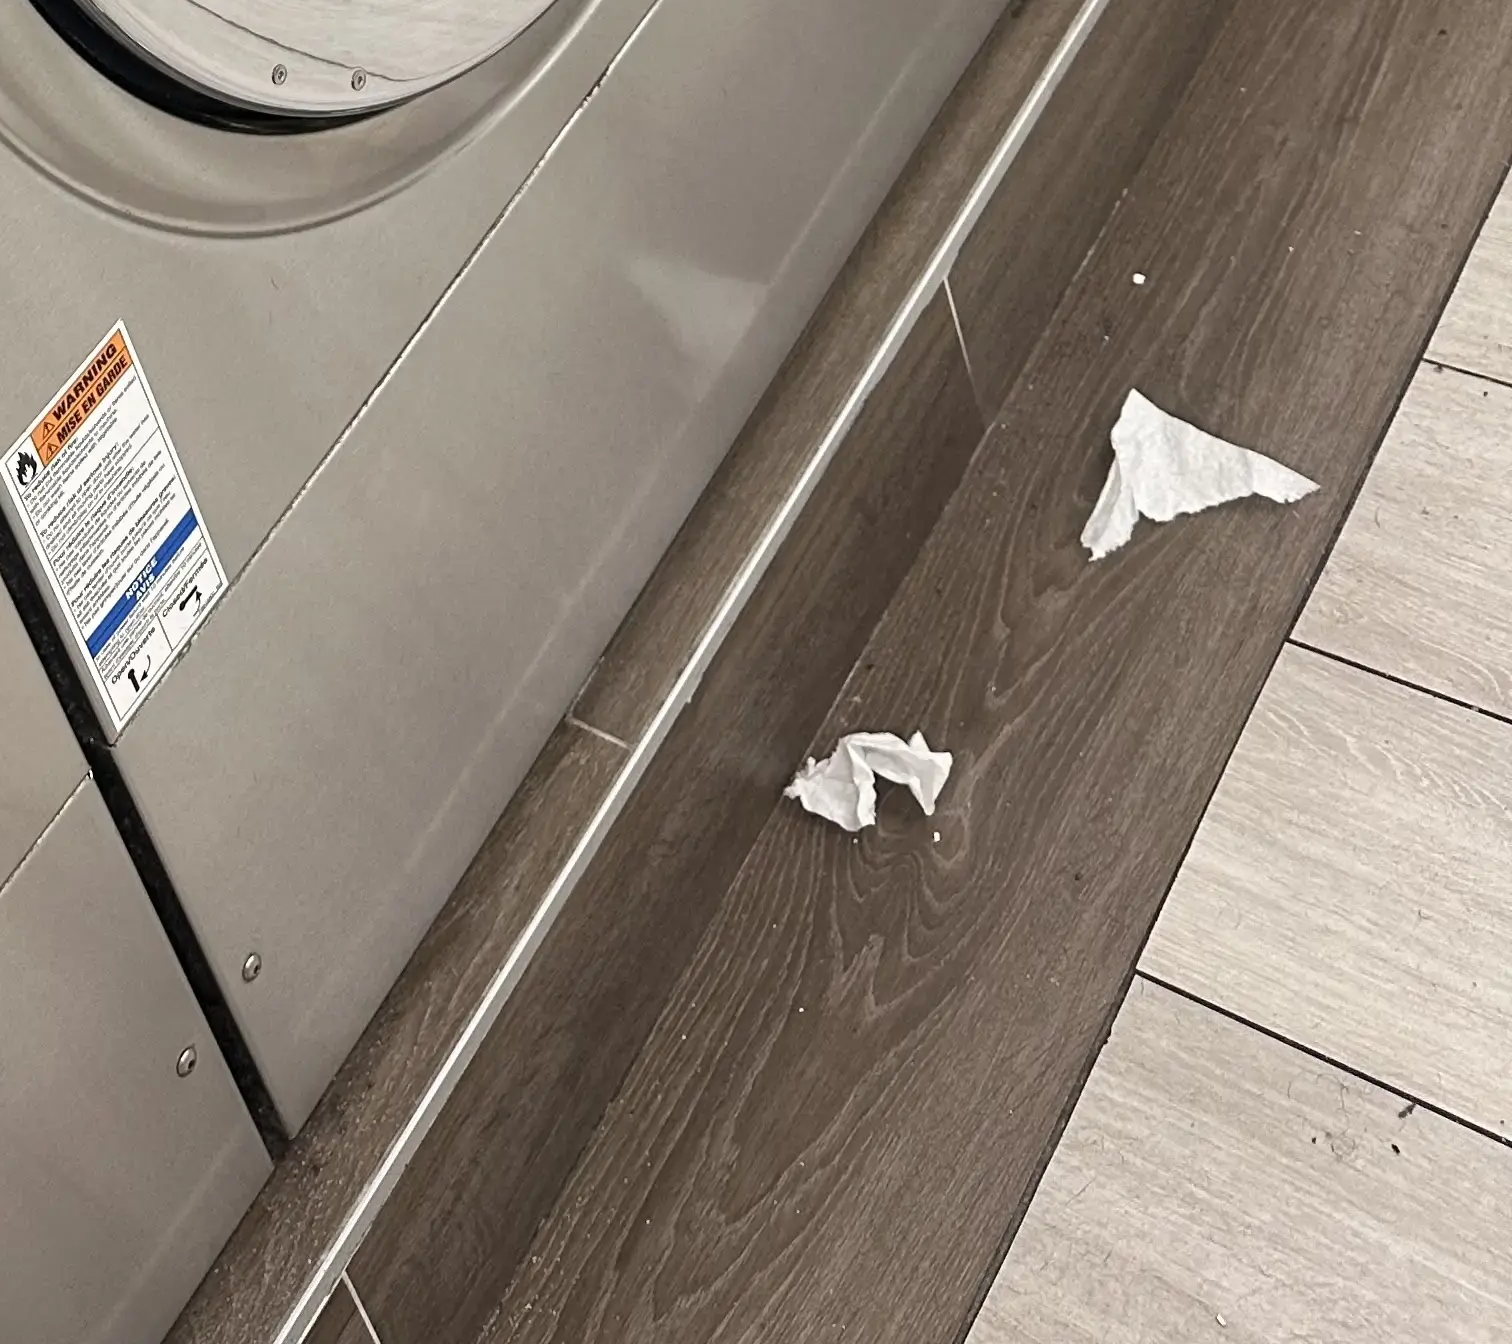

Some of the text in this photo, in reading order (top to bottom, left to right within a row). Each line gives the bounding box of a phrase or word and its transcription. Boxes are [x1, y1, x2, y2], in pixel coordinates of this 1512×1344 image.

[51, 340, 117, 423] WARNING
[56, 353, 128, 445] MISE EN GARDE
[124, 555, 157, 601] NOTICE
[134, 570, 155, 601] AVIS
[110, 623, 156, 687] Open/Ouverte
